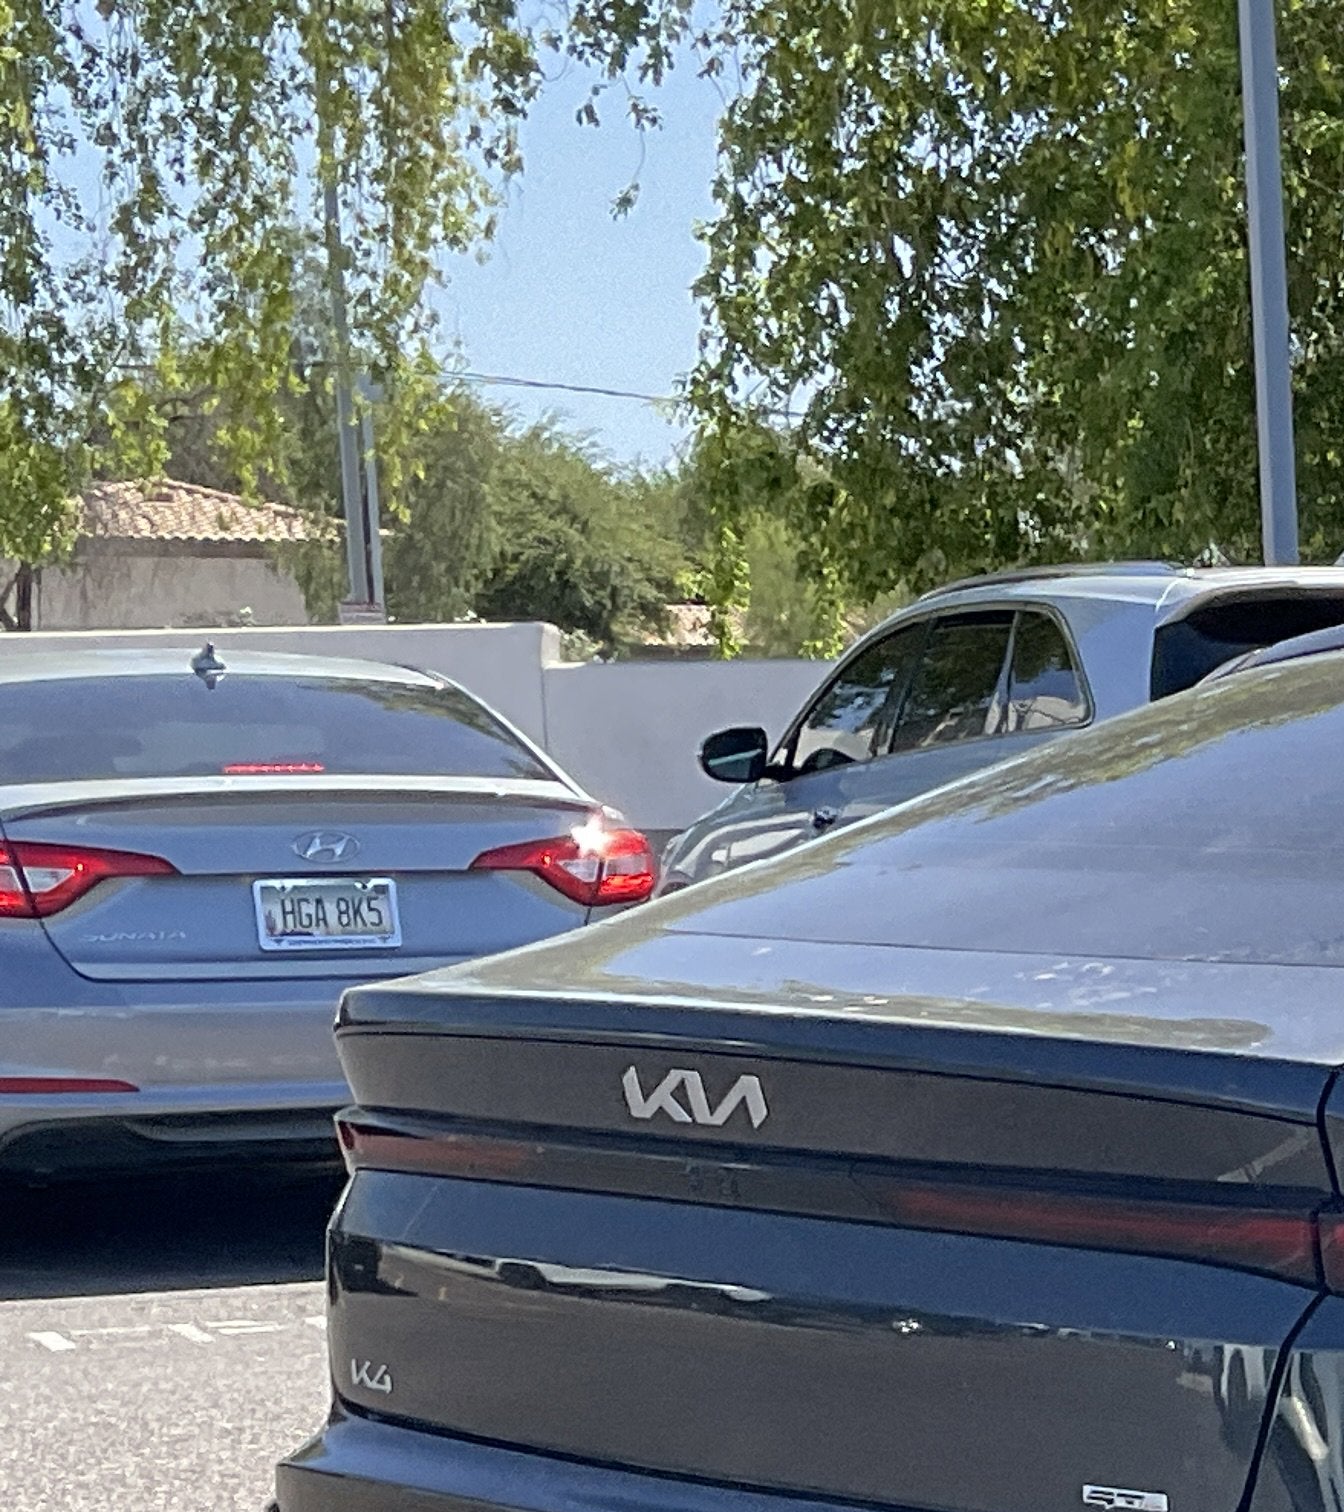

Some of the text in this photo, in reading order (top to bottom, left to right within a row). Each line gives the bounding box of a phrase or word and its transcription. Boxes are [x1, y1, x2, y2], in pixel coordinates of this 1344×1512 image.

[280, 896, 383, 929] HGA 8K5
[622, 1064, 769, 1129] KIA
[351, 1358, 392, 1394] K4
